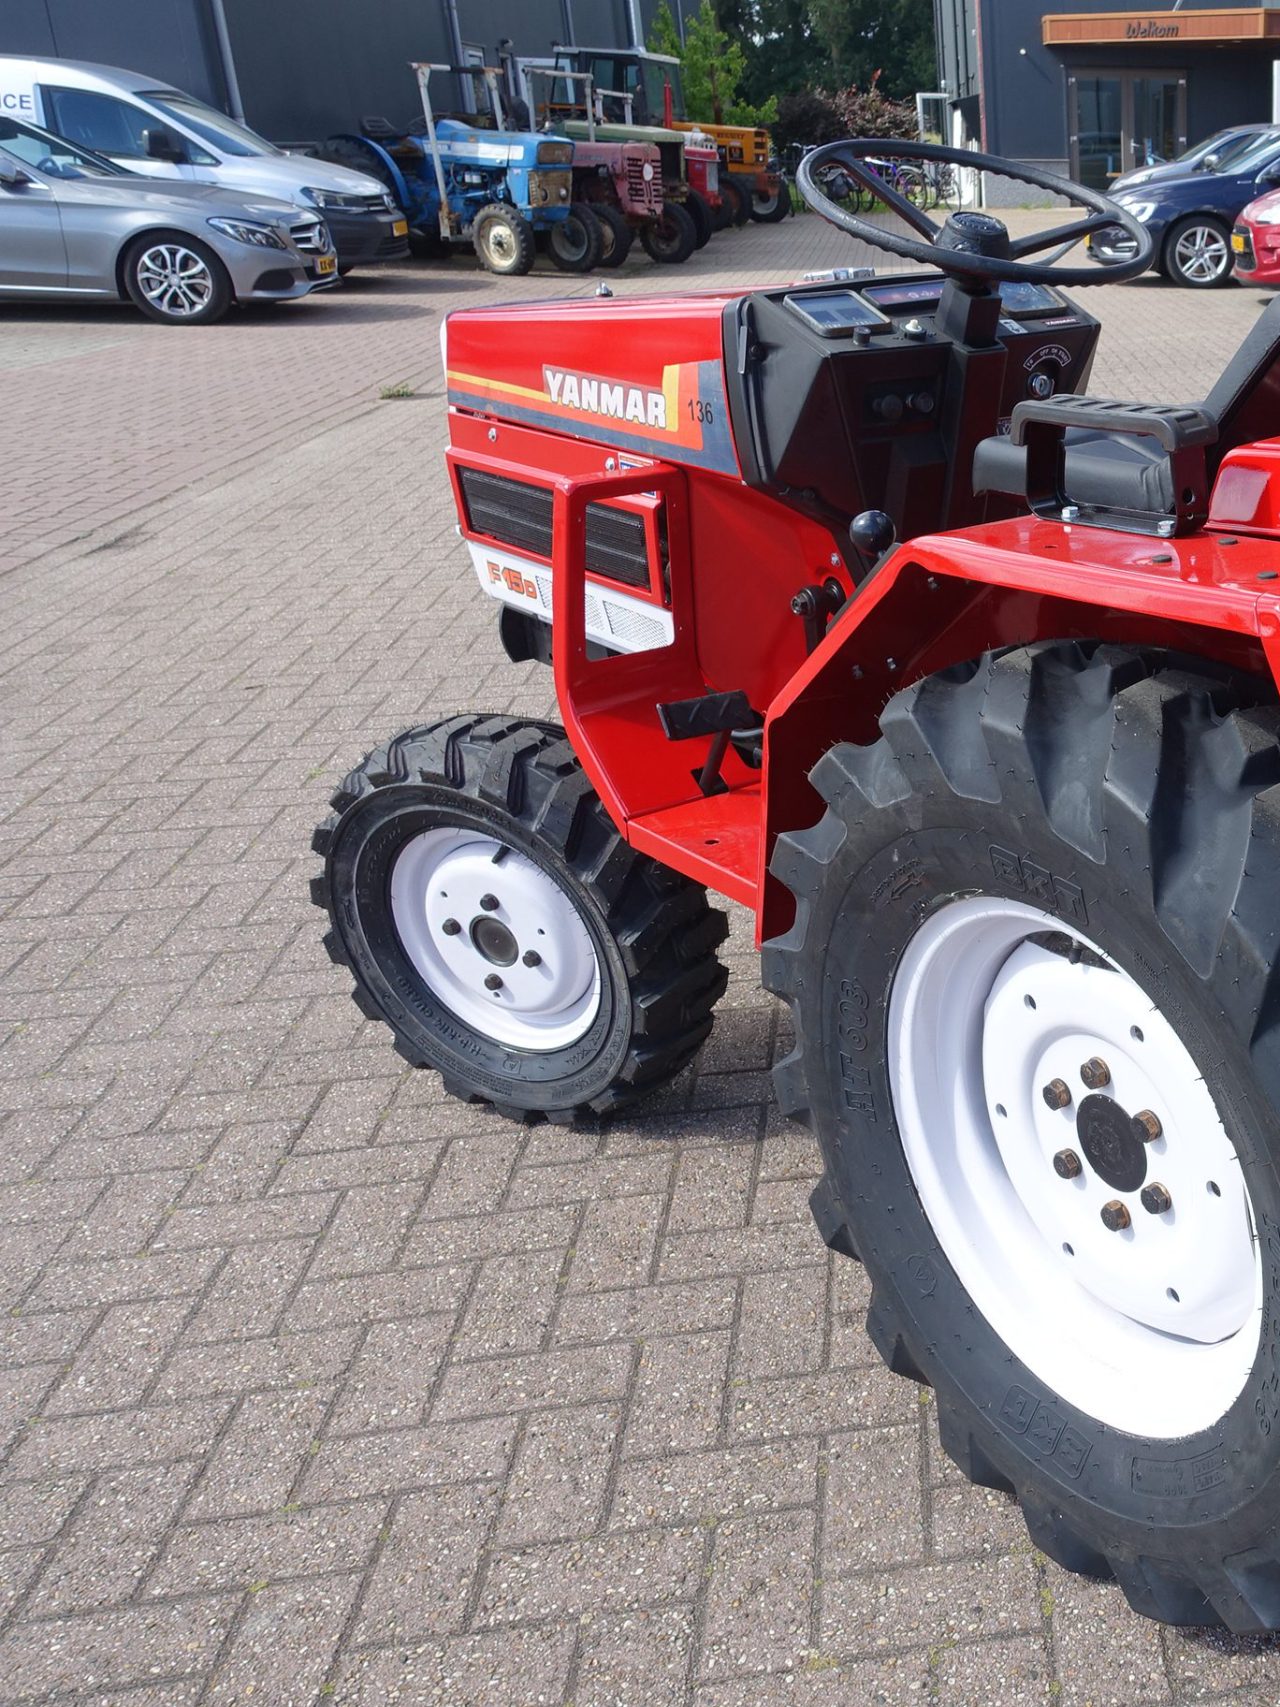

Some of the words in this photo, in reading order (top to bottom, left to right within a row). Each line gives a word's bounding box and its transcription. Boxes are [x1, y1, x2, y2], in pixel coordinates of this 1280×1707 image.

[1126, 19, 1179, 39] Welkom
[545, 369, 667, 429] YANMAR
[688, 398, 714, 425] 136
